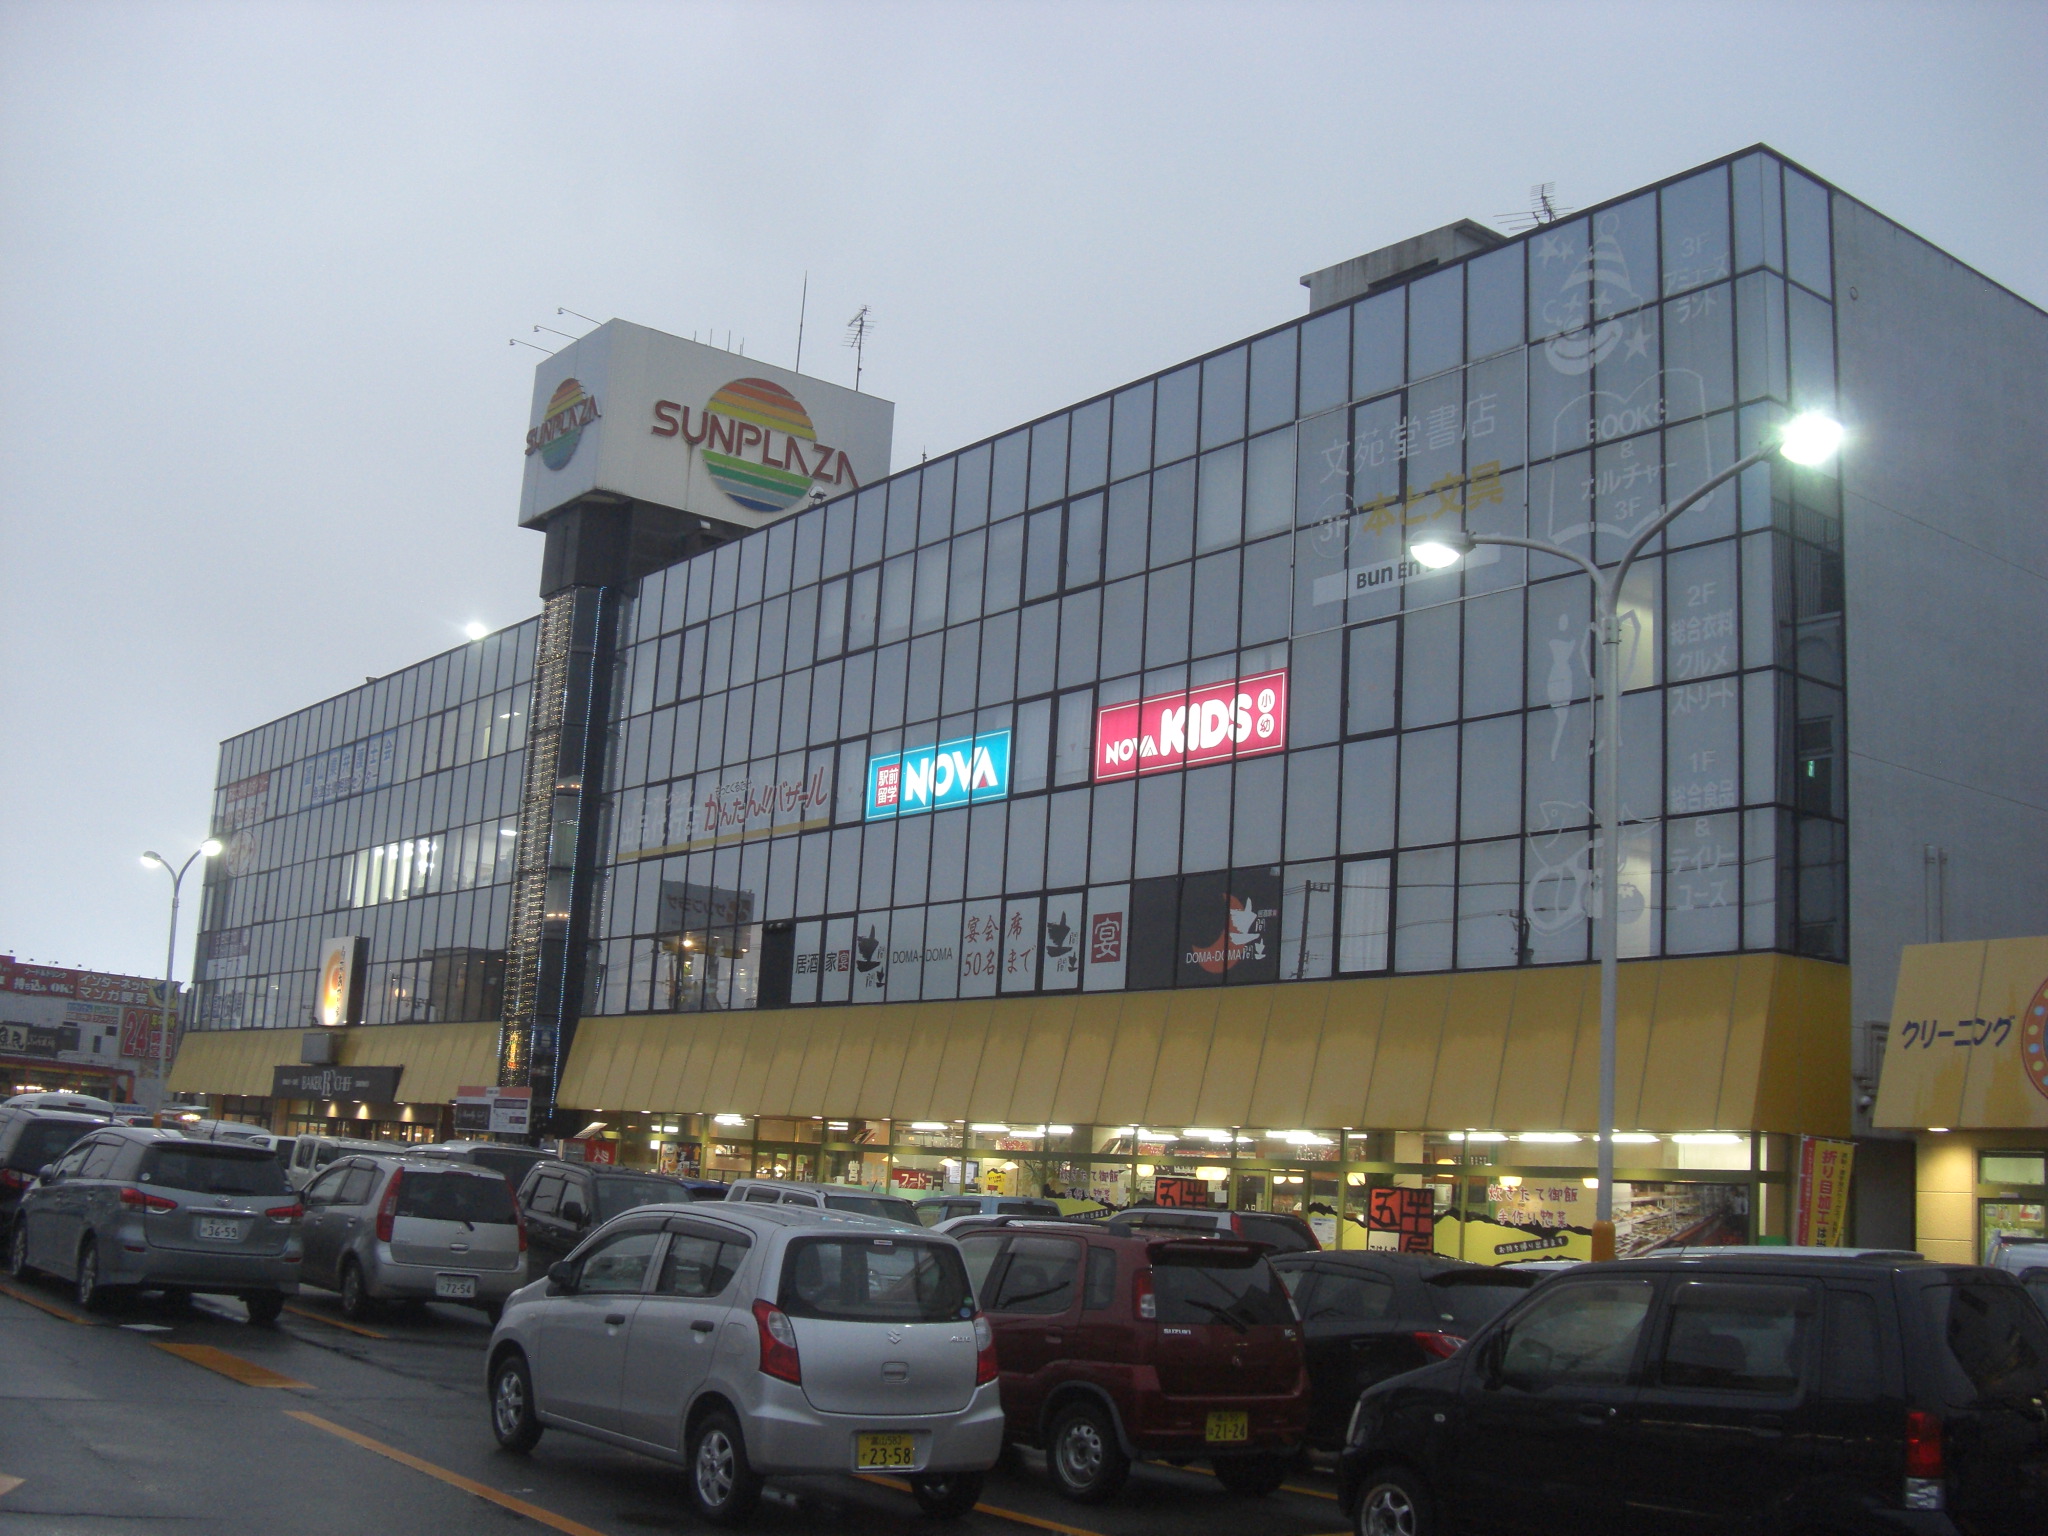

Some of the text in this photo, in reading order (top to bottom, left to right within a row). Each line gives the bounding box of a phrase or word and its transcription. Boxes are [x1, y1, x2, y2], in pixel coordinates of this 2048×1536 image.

[525, 395, 602, 456] SUNPLAZA
[1587, 398, 1670, 442] BOOKS
[651, 399, 860, 489] SUNPLAZA
[1320, 393, 1497, 484] 文苑堂書店
[1581, 462, 1678, 501] カルチャー
[1363, 460, 1505, 537] 本と文具
[1615, 496, 1643, 521] 3F
[1687, 581, 1717, 608] 2F
[1672, 680, 1735, 715] ストリート
[1105, 693, 1253, 767] NOVA KIDS
[904, 746, 999, 806] NOVA
[1688, 749, 1717, 774] 1F
[878, 767, 898, 787] 駅前
[877, 786, 898, 806] 留学
[1694, 818, 1711, 838] &
[964, 911, 1023, 943] 宴会席
[1092, 917, 1120, 960] 宴
[892, 947, 953, 964] DOMA-DOMA
[963, 944, 1037, 978] 50名まで
[80, 974, 151, 991] インターネット
[80, 985, 149, 1005] マンガ喫茶
[122, 1010, 150, 1058] 24
[1901, 1014, 2016, 1050] クリーニング
[1488, 1184, 1579, 1203] 炊きたて御飯
[208, 1225, 237, 1238] 36-59
[1497, 1208, 1567, 1229] 手作り惣菜
[1215, 1423, 1246, 1440] 21-24
[870, 1447, 911, 1465] 23-58
